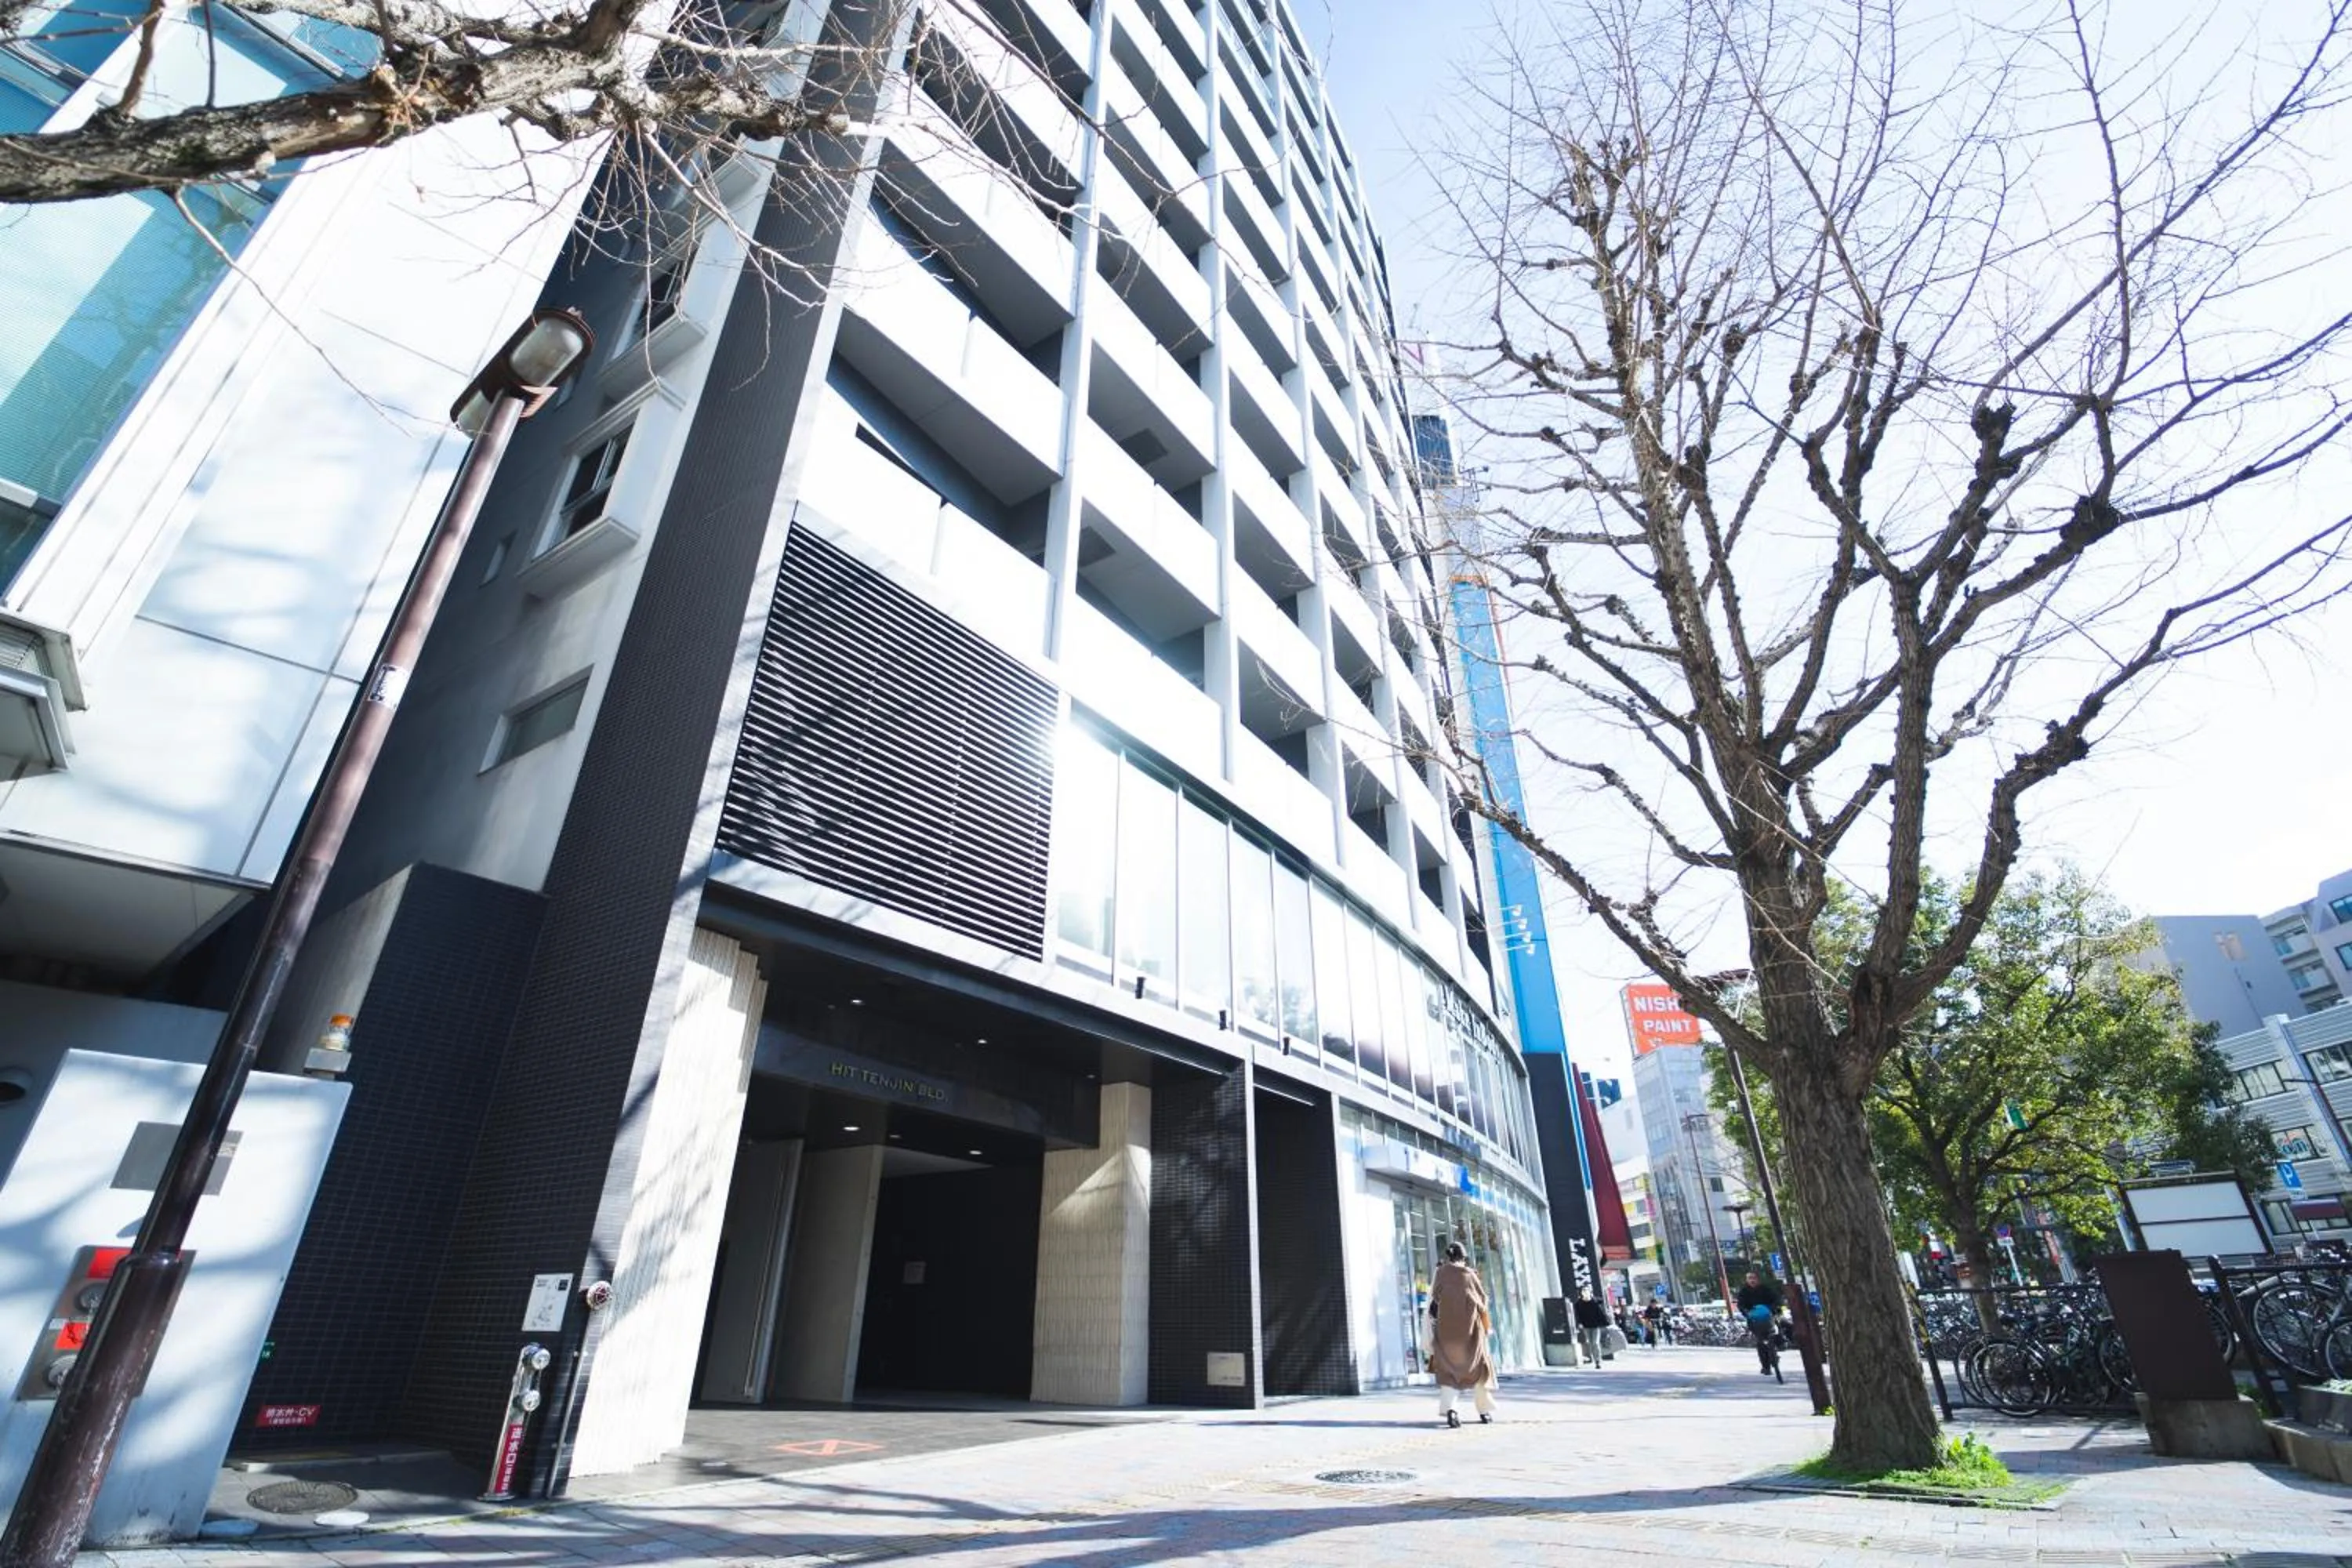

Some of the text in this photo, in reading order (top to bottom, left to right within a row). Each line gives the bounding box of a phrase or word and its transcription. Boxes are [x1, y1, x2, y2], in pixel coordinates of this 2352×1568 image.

[1633, 996, 1682, 1012] NISH
[1642, 1019, 1692, 1033] PAINT
[831, 1062, 857, 1078] HIT
[862, 1069, 913, 1093] TENJIN
